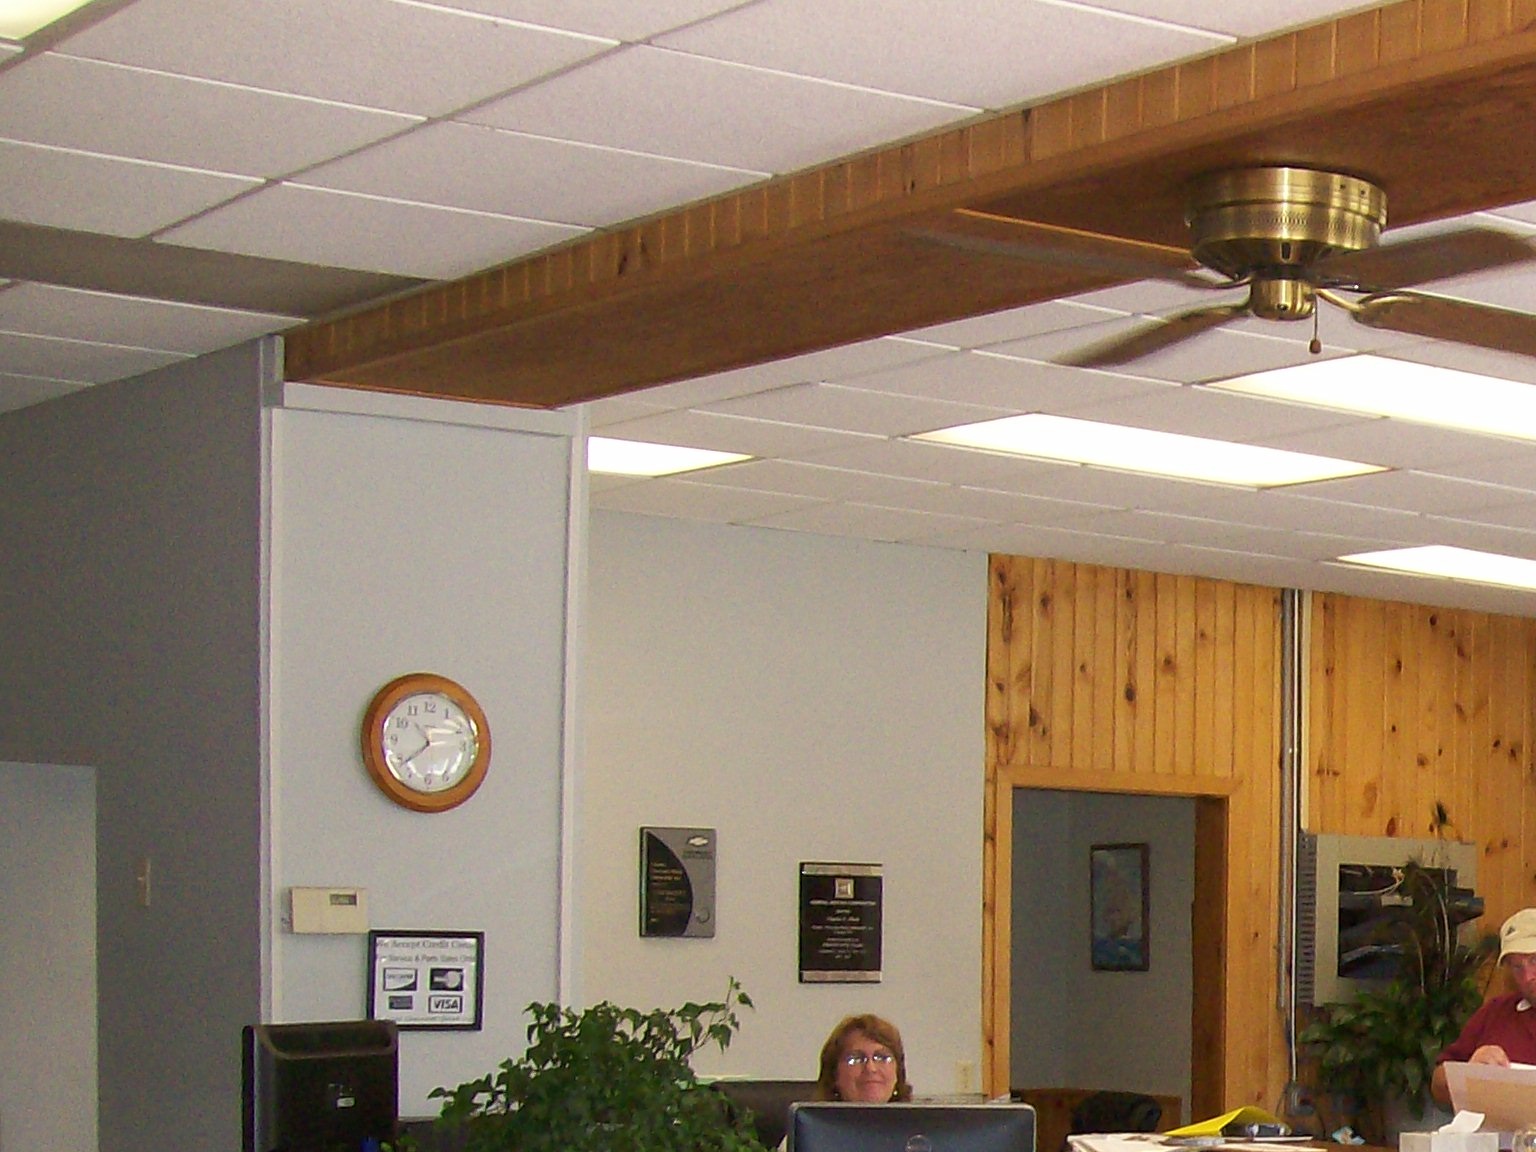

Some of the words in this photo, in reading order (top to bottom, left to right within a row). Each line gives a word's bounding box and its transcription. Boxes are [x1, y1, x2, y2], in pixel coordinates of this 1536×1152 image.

[407, 705, 418, 716] 11
[424, 701, 437, 714] 12
[396, 717, 409, 729] 10
[434, 999, 459, 1009] VISA
